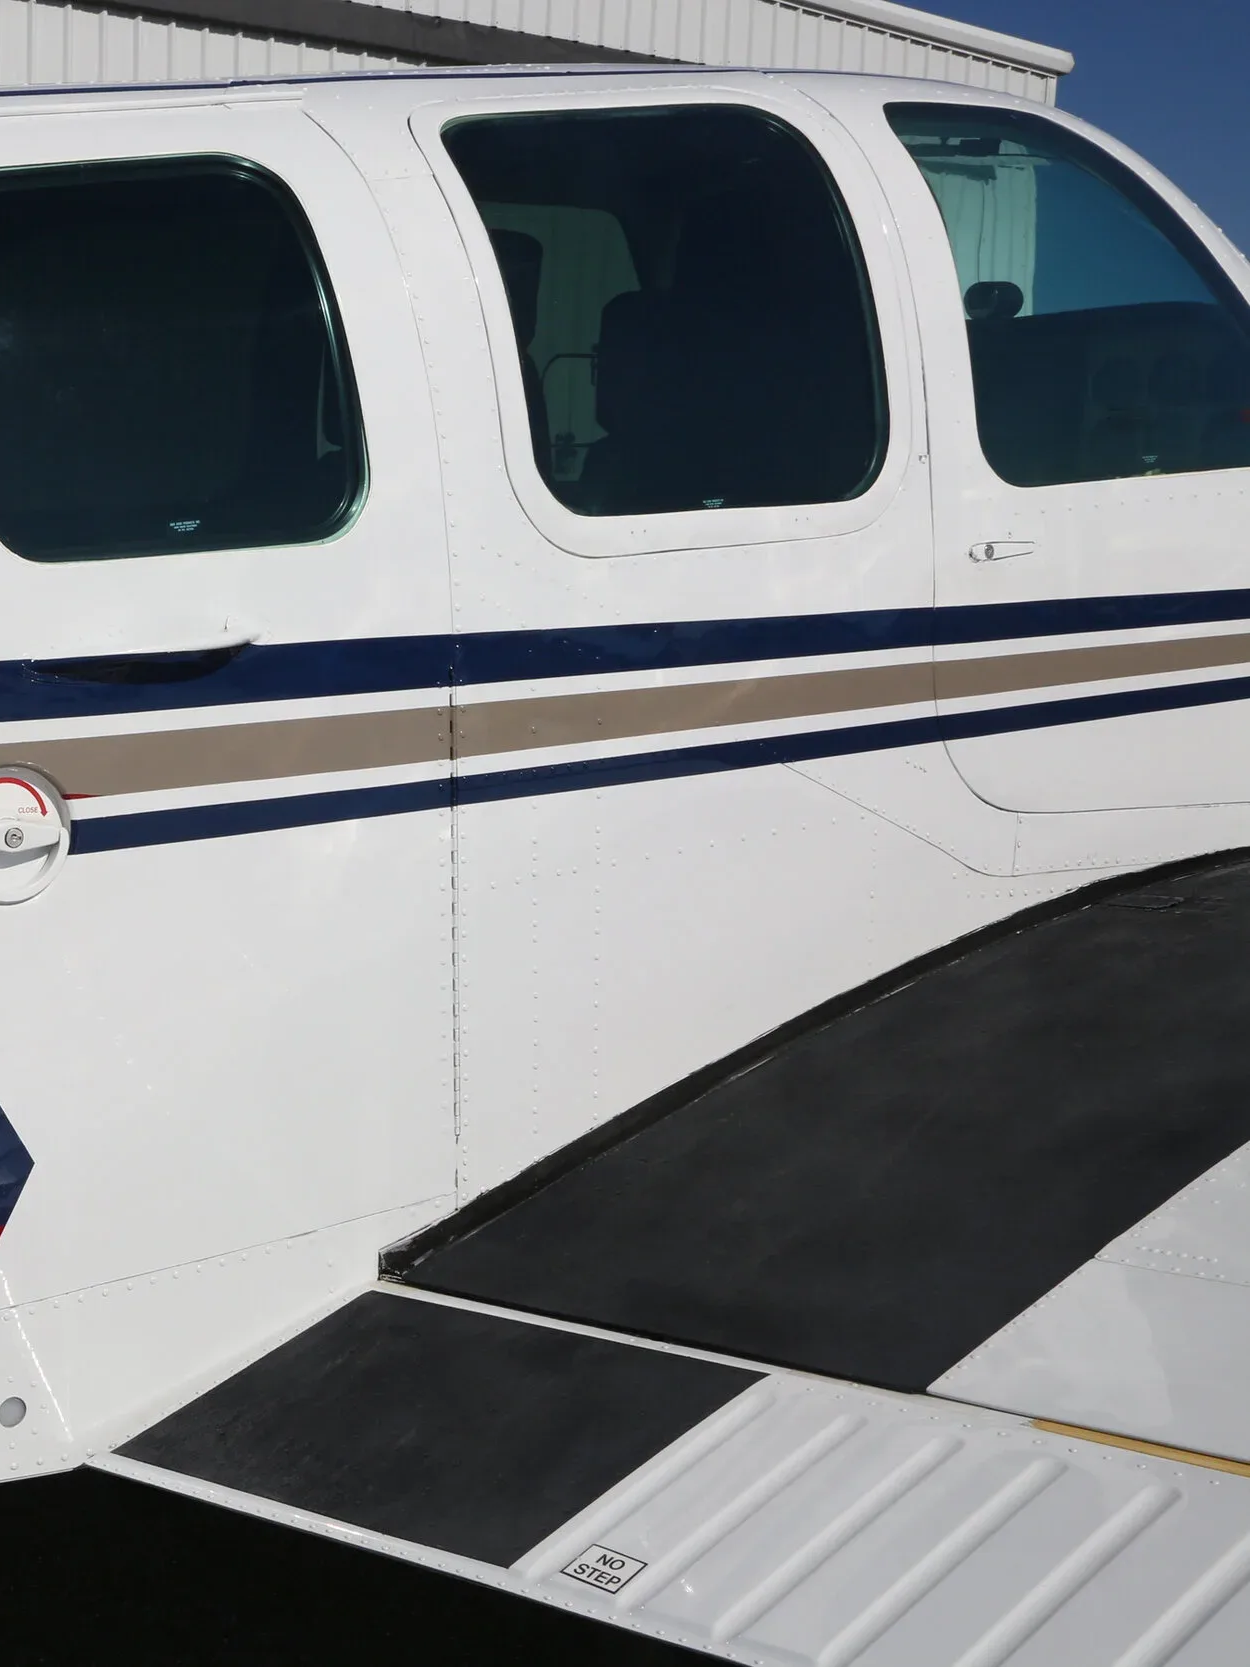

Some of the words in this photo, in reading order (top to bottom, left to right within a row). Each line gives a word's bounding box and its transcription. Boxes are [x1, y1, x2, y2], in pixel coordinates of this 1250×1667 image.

[18, 806, 38, 814] CLOSE
[595, 1553, 626, 1571] NO
[573, 1563, 622, 1586] STEP
